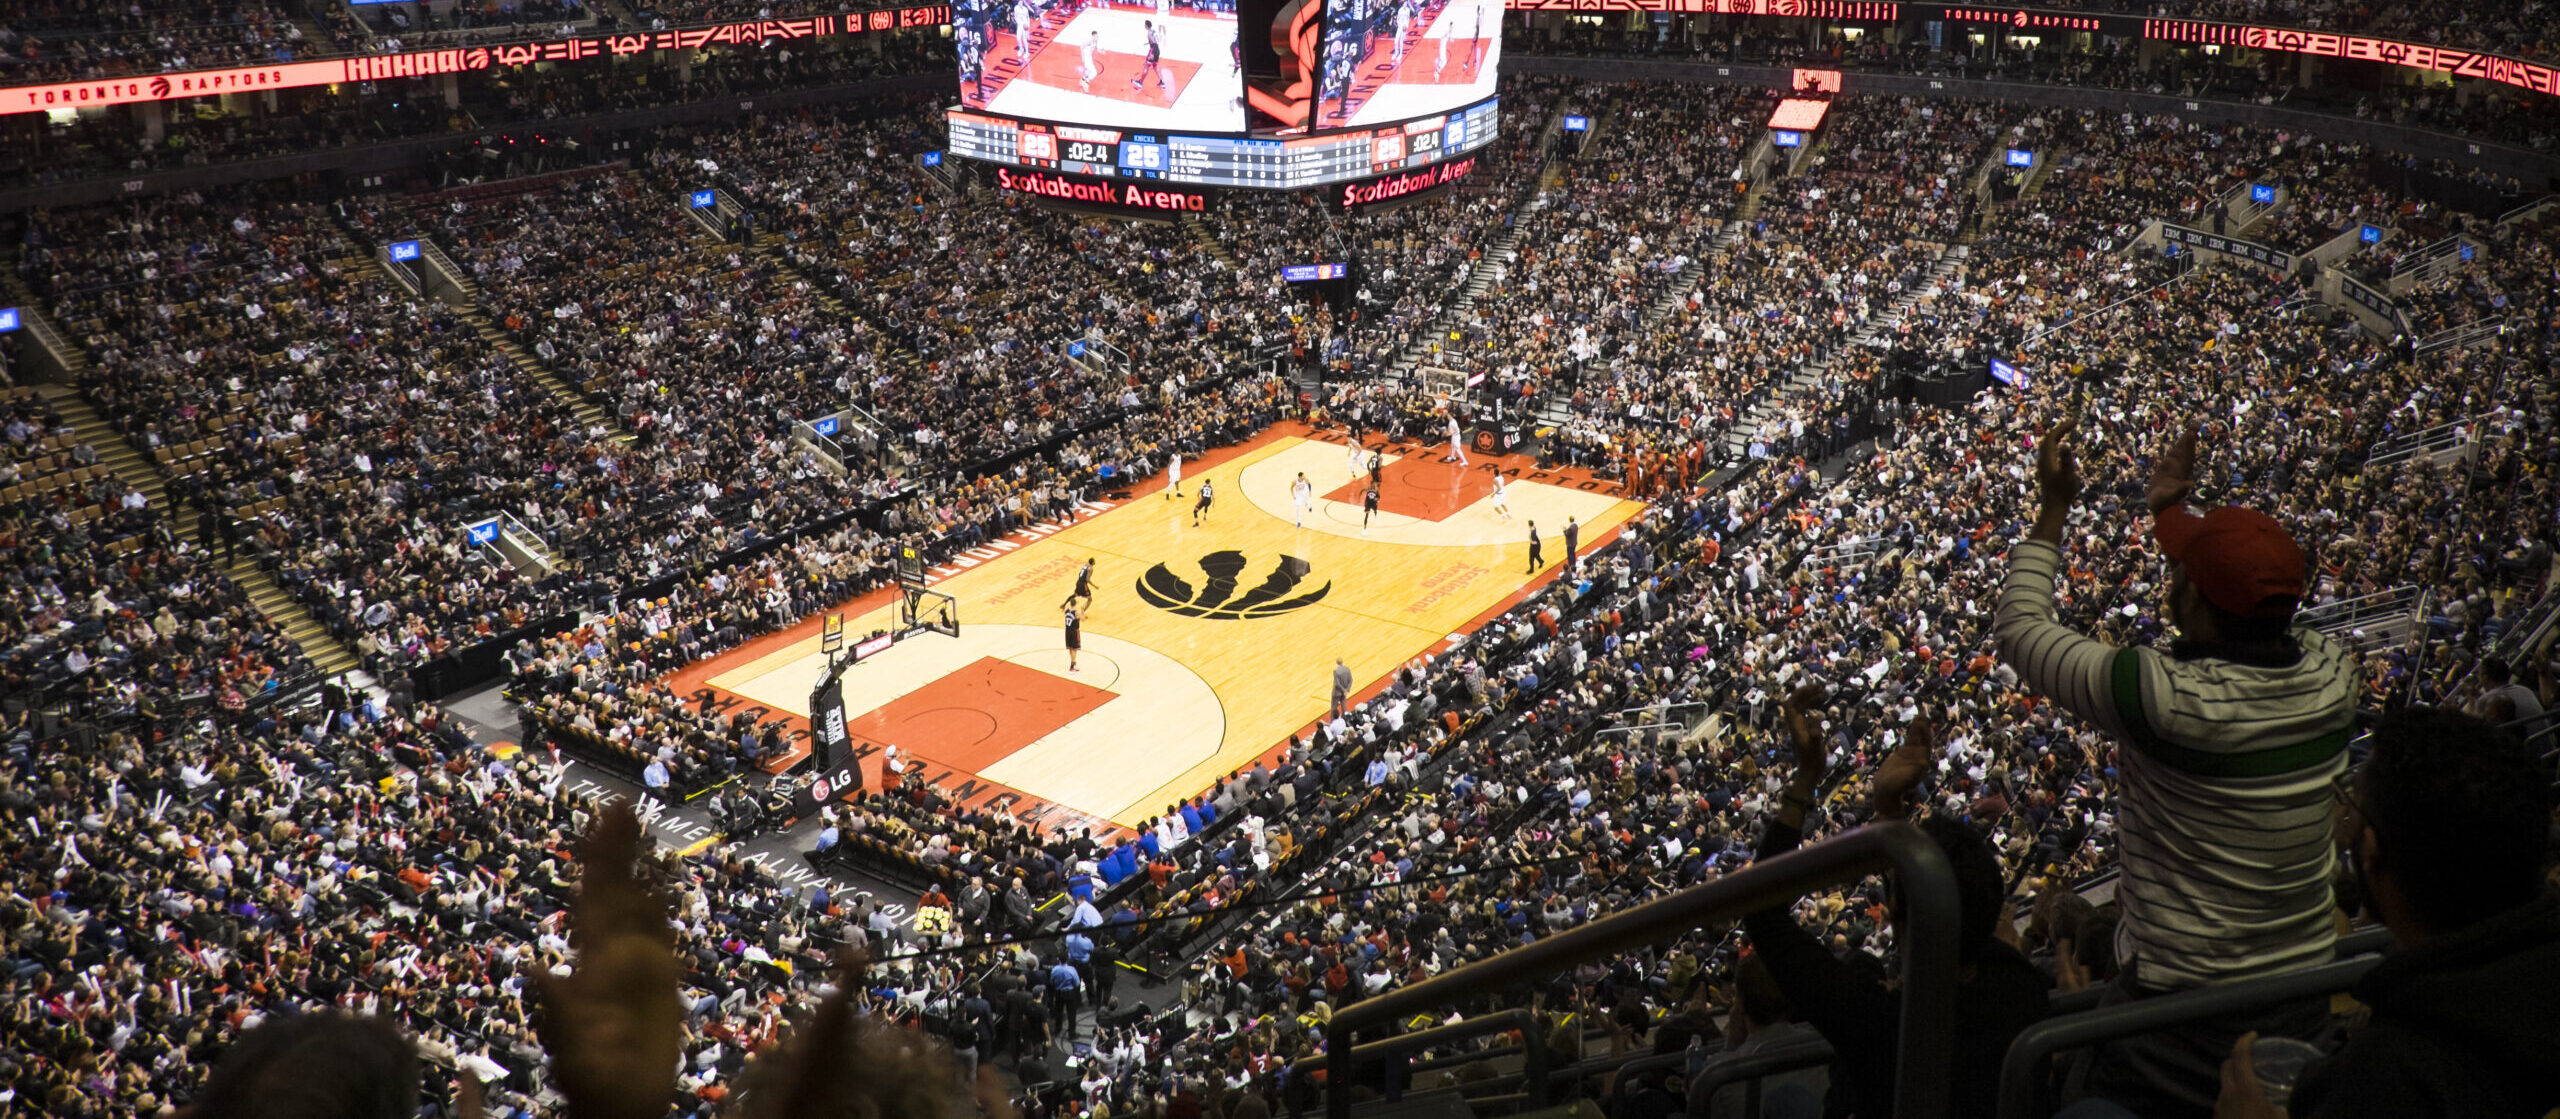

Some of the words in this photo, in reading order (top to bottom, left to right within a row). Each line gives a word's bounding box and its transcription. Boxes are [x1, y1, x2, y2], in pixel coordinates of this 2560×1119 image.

[1944, 9, 2008, 24] TORONTO
[2033, 15, 2100, 31] RAPTORS
[1718, 68, 1729, 76] 113
[28, 84, 138, 105] TORONTO
[183, 71, 282, 91] RAPTORS
[1930, 81, 1943, 89] 114
[1569, 119, 1584, 129] Bell
[1023, 133, 1051, 158] 25
[1780, 133, 1796, 145] Bell
[1068, 142, 1108, 163] :02.4
[1127, 144, 1160, 168] 25
[1377, 136, 1401, 161] 25
[2011, 152, 2029, 165] Bell
[123, 180, 144, 191] 107
[998, 167, 1119, 204] Scotiabank
[1125, 184, 1205, 211] Arena
[1342, 165, 1438, 207] Scotiabank
[1438, 157, 1476, 184] Arena
[695, 193, 711, 206] Bell
[2164, 228, 2181, 240] IBM
[2186, 232, 2203, 245] IBM
[2208, 238, 2226, 250] IBM
[2231, 243, 2249, 256] IBM
[394, 245, 415, 260] Bell
[819, 420, 835, 434] Bell
[1510, 431, 1521, 445] LG
[472, 524, 493, 541] Bell
[903, 547, 916, 559] 24
[830, 769, 852, 792] LG
[569, 779, 627, 807] THE
[1257, 1060, 1266, 1074] 2
